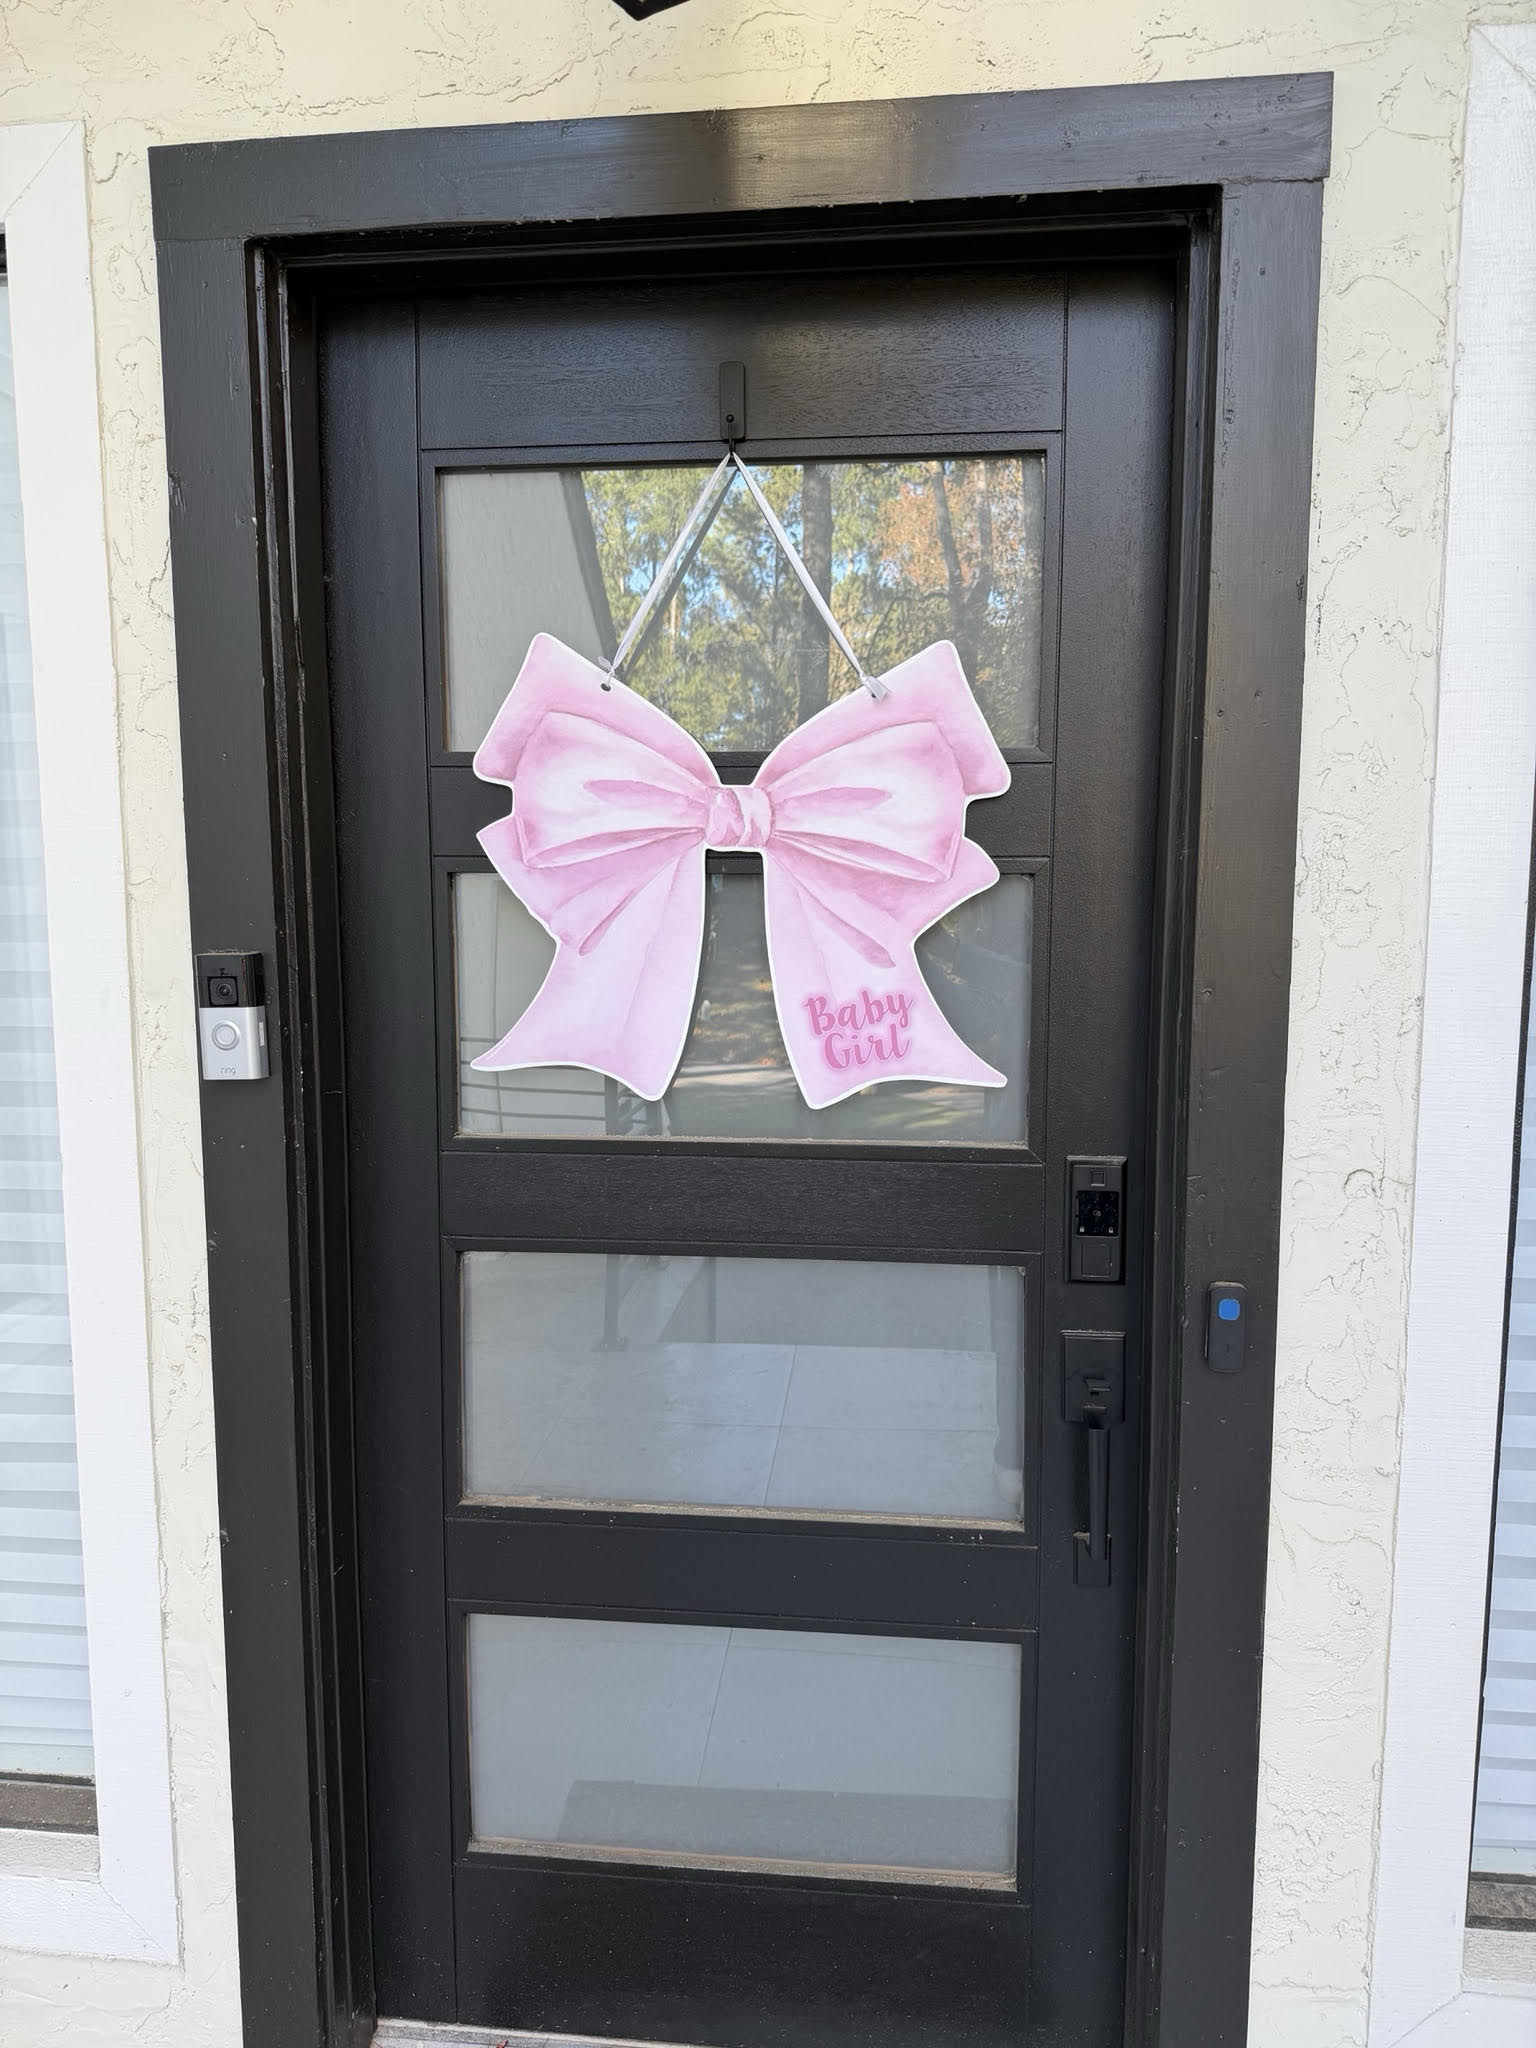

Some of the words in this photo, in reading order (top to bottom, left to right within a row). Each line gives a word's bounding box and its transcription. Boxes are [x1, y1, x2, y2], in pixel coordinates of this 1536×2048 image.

[804, 990, 913, 1035] Baby
[824, 1023, 911, 1069] Girl
[220, 1065, 236, 1075] ring
